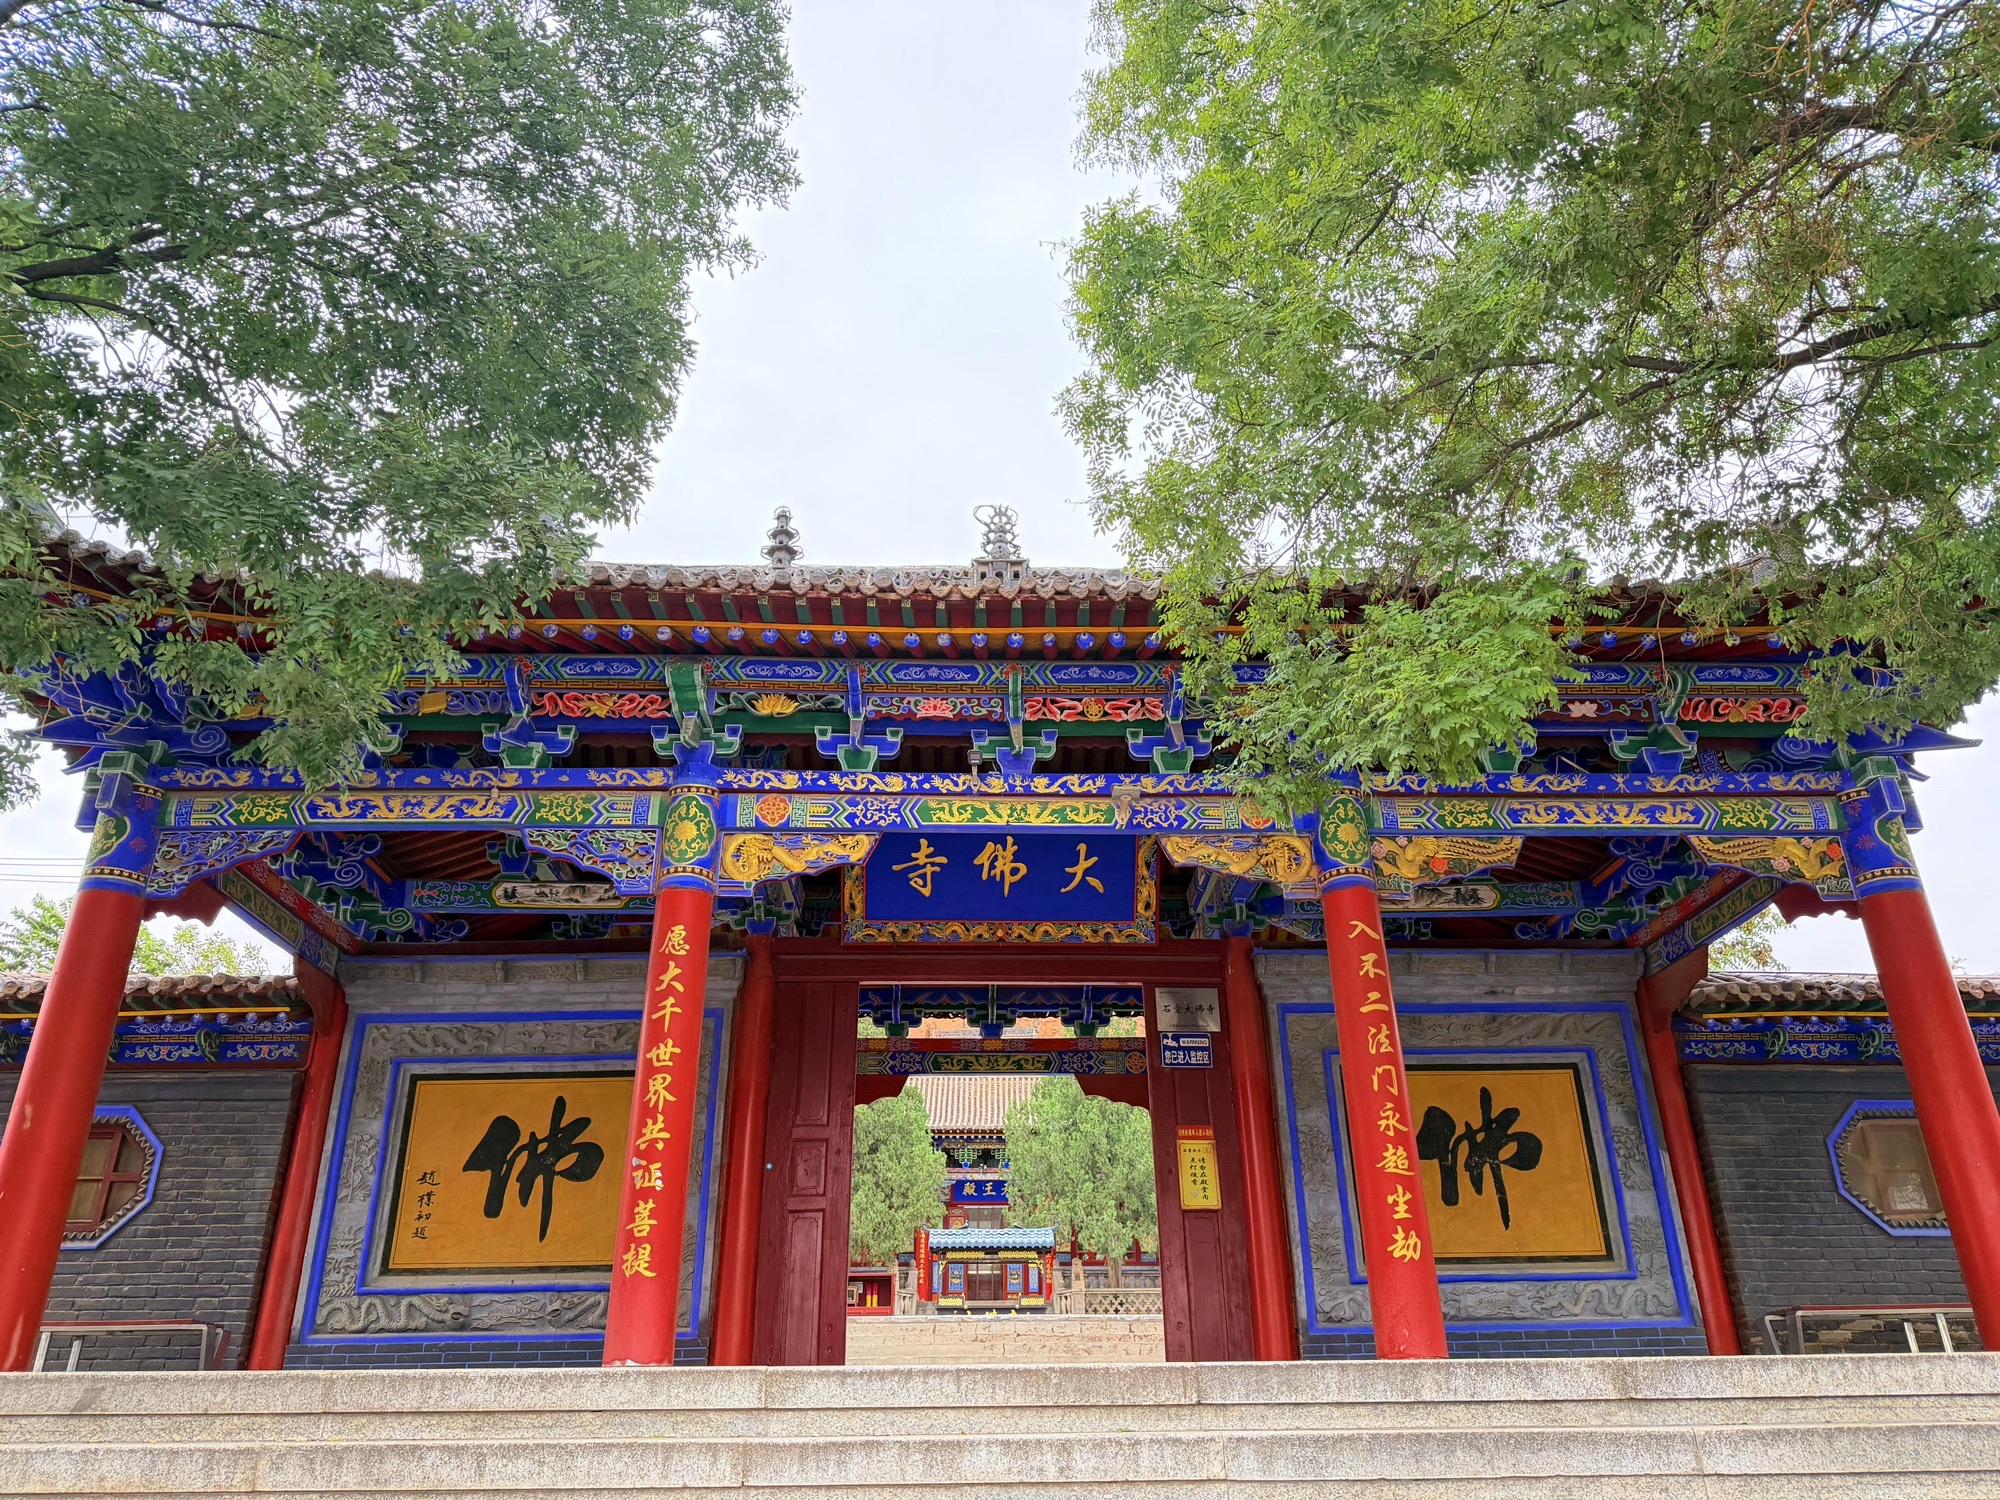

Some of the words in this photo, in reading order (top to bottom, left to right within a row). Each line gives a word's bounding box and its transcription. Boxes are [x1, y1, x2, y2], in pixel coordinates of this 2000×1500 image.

[892, 836, 1104, 897] 大佛寺
[1162, 1003, 1215, 1015] 石空大佛寺
[1165, 1050, 1210, 1064] 您已进入监控区
[621, 924, 690, 1279] 愿大千世界共证菩提
[462, 1095, 605, 1243] 佛
[1416, 1086, 1543, 1231] 佛
